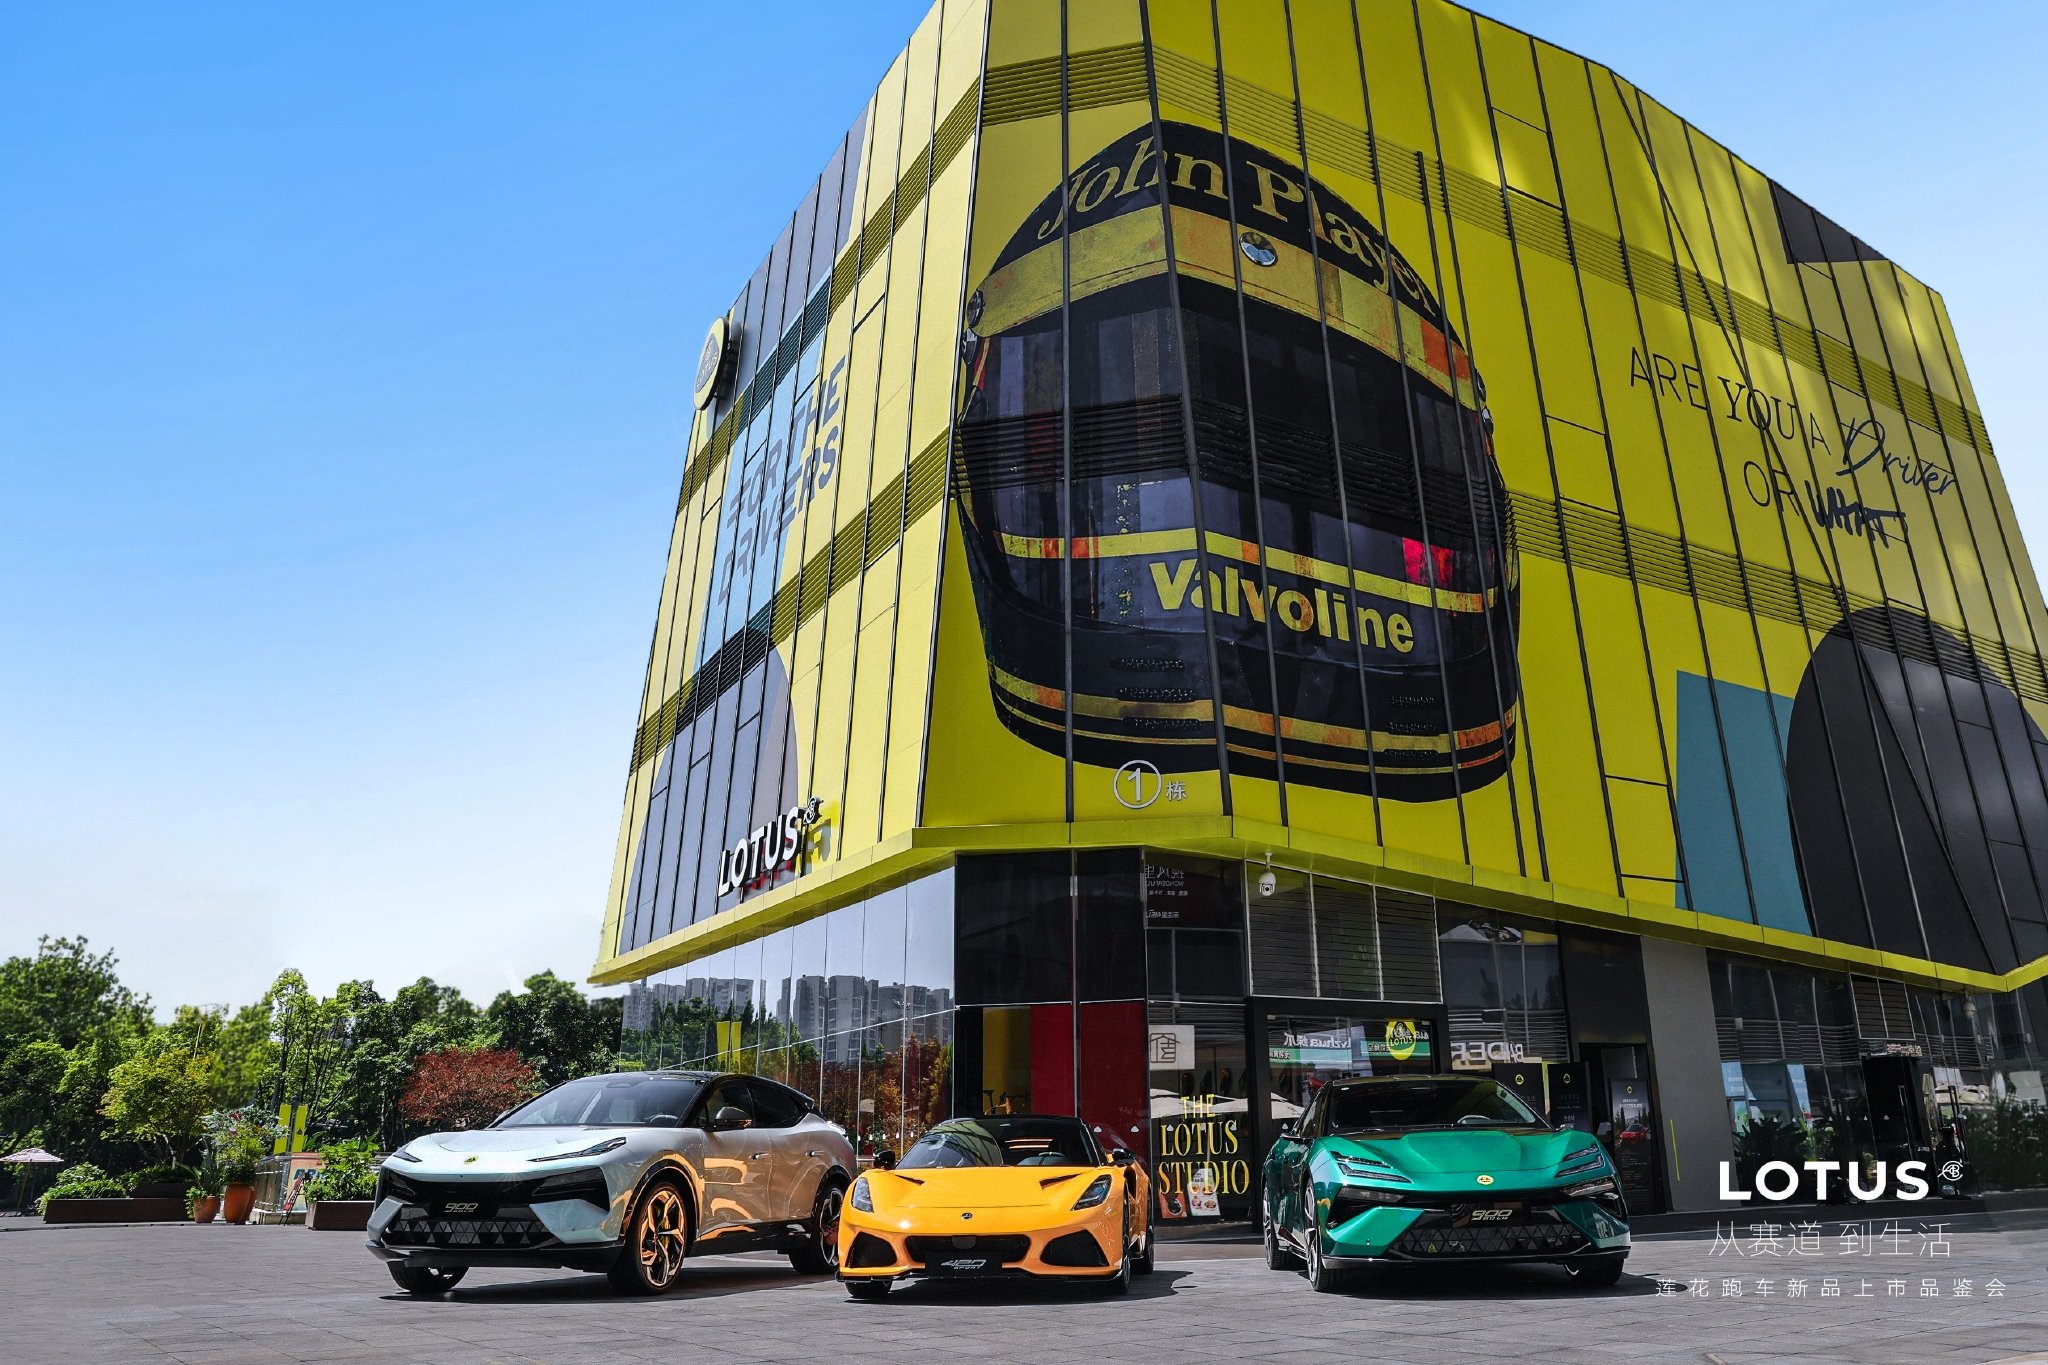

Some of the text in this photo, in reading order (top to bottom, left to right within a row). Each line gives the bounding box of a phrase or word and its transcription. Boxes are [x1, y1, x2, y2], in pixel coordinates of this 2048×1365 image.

[1037, 135, 1229, 240] John
[726, 354, 847, 530] FOR THE
[1630, 346, 1957, 495] ARE YOU A Driver
[1743, 460, 1801, 517] OR
[717, 425, 840, 607] DRIVERS
[1149, 558, 1414, 653] Valvoline
[1165, 780, 1188, 802] 栋
[718, 806, 800, 897] LOTUS
[1390, 1035, 1413, 1047] LOTUS
[1181, 1093, 1216, 1119] THE
[1160, 1119, 1239, 1156] LOTUS
[1158, 1160, 1250, 1195] STUDIO
[444, 1202, 479, 1213] 900
[1471, 1209, 1513, 1221] 900
